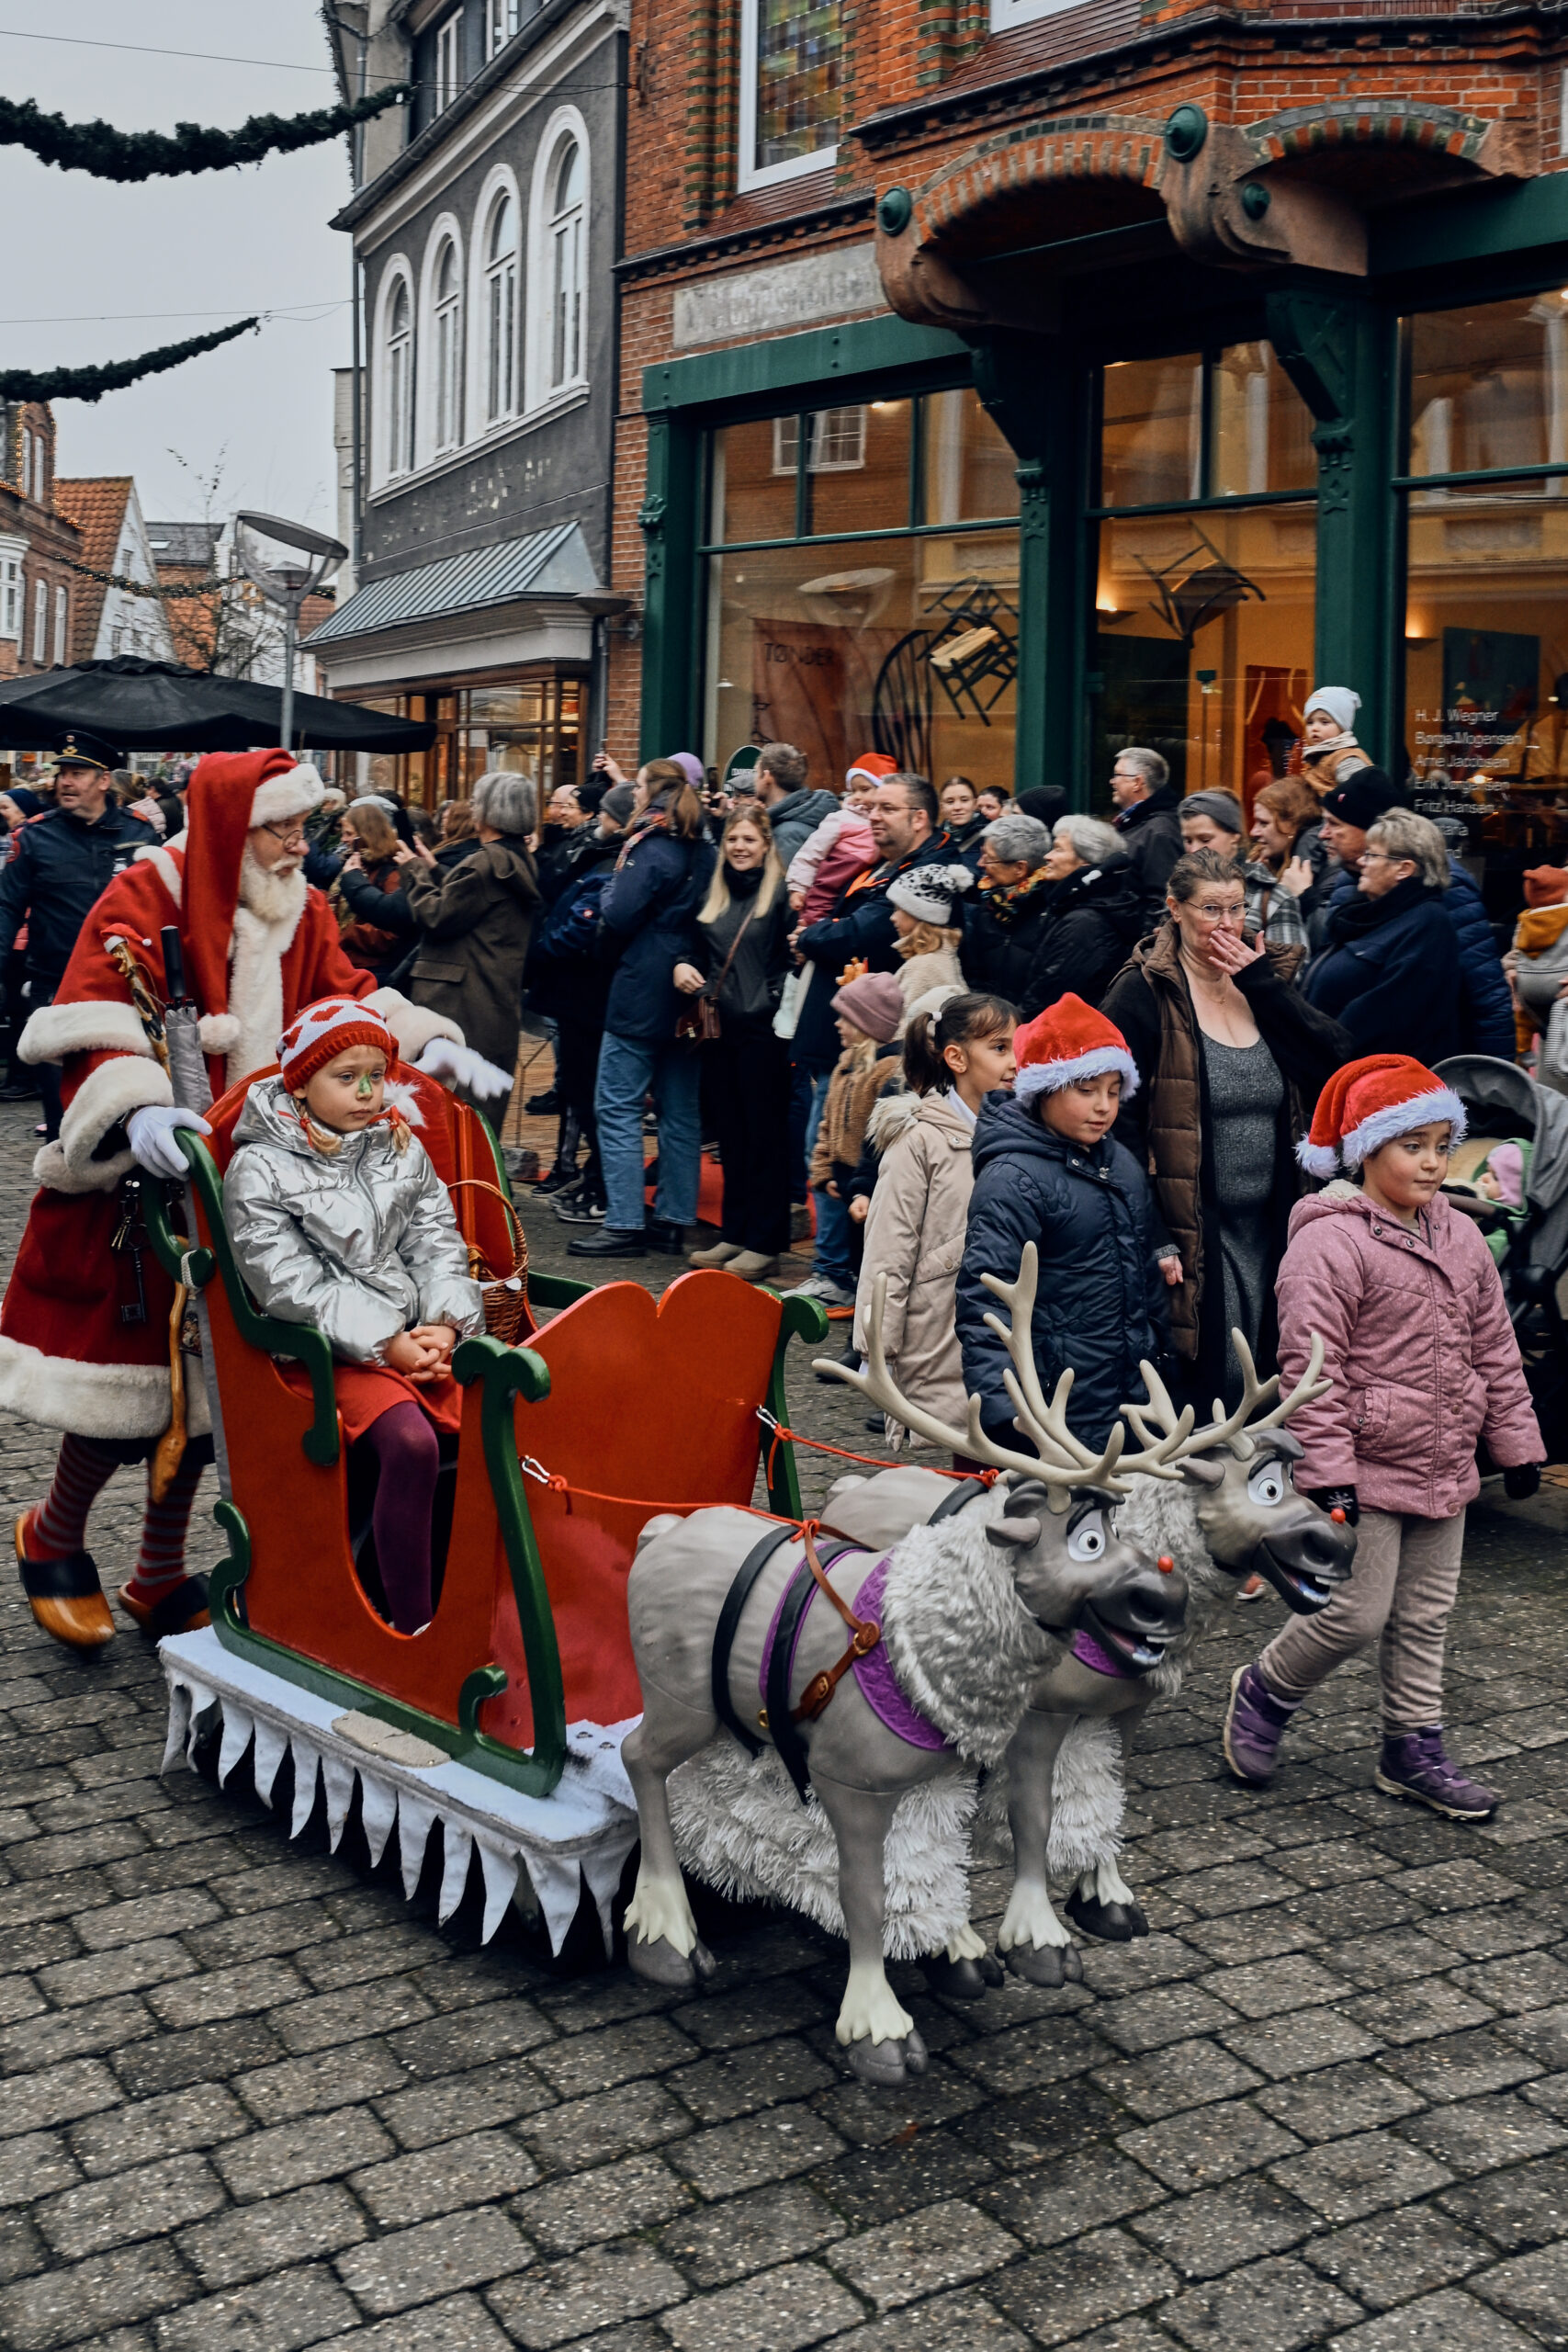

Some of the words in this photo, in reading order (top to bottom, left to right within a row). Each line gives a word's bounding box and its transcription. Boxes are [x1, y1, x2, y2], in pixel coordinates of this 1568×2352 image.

[1447, 708, 1499, 725] Wegner
[1454, 731, 1522, 748] Mogensen
[1416, 754, 1446, 768] Arne
[1447, 754, 1509, 768] Jacobsen
[1443, 799, 1495, 814] Hansen
